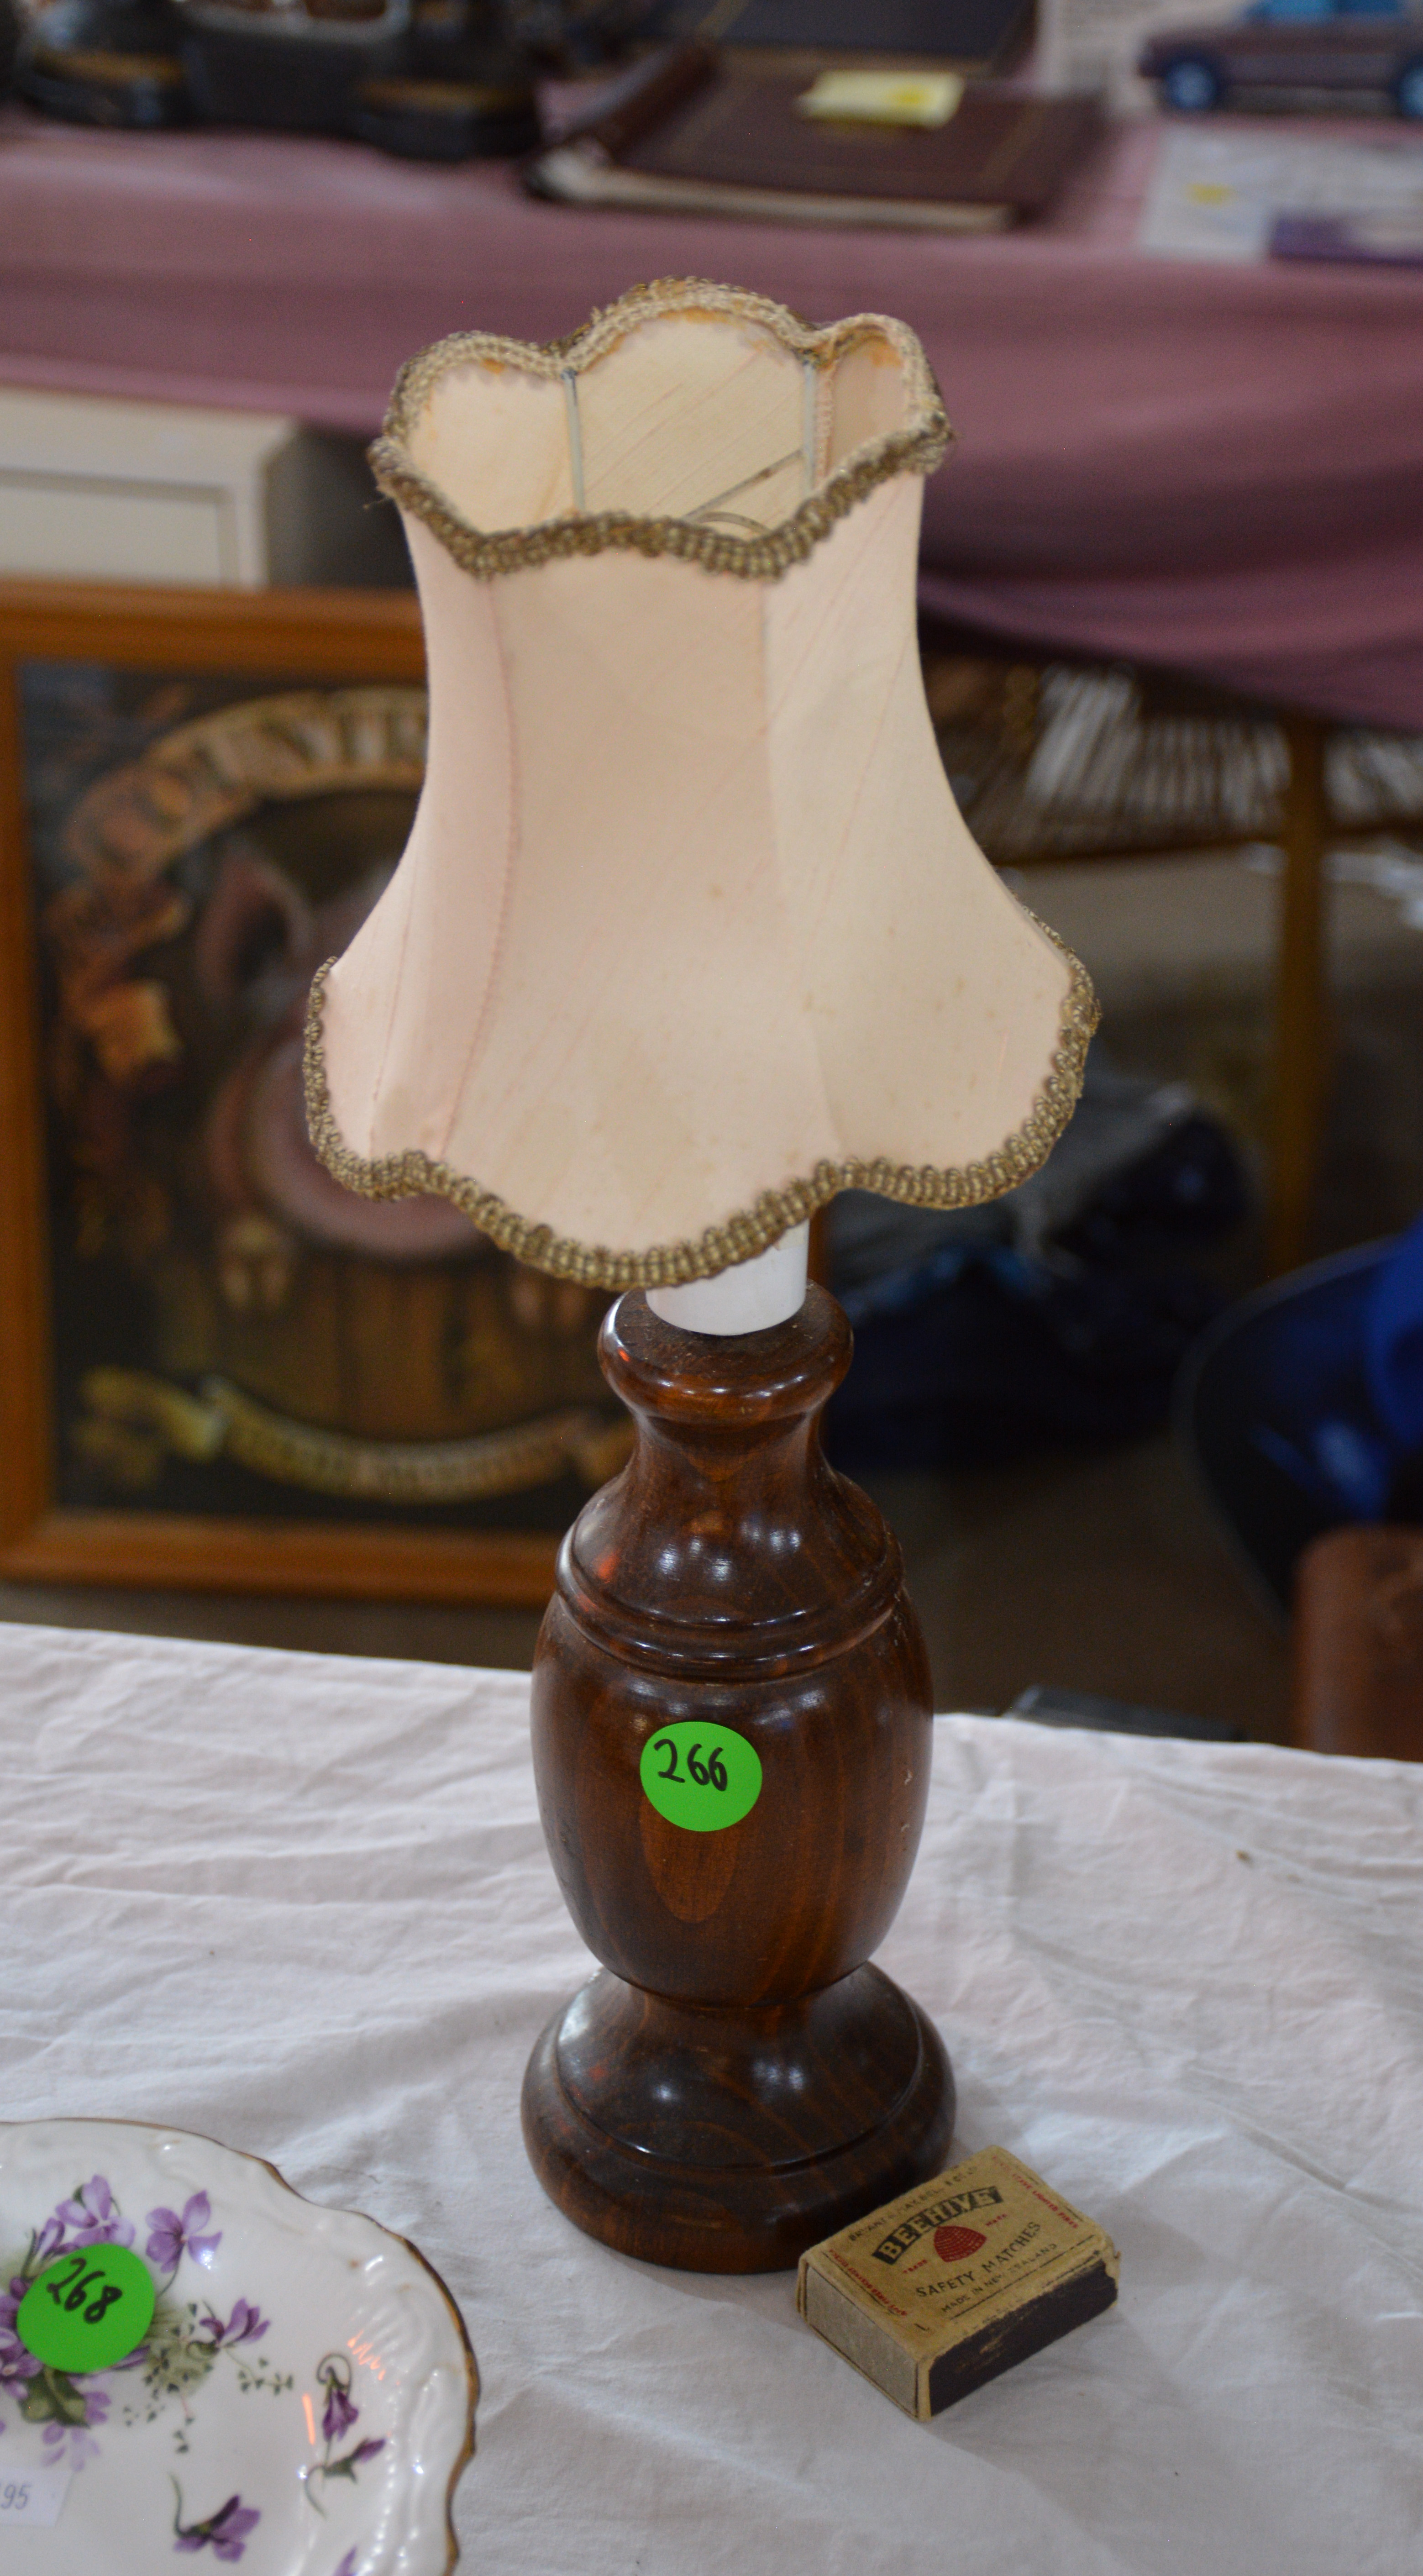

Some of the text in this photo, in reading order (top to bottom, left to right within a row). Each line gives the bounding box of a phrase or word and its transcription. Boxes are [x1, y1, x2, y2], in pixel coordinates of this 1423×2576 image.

[653, 1738, 728, 1792] 266
[876, 2187, 998, 2262] BEEHIVE
[46, 2257, 123, 2325] 268
[915, 2221, 1041, 2298] SAFETY MATCHES
[941, 2293, 971, 2313] MADE
[971, 2286, 984, 2296] IN
